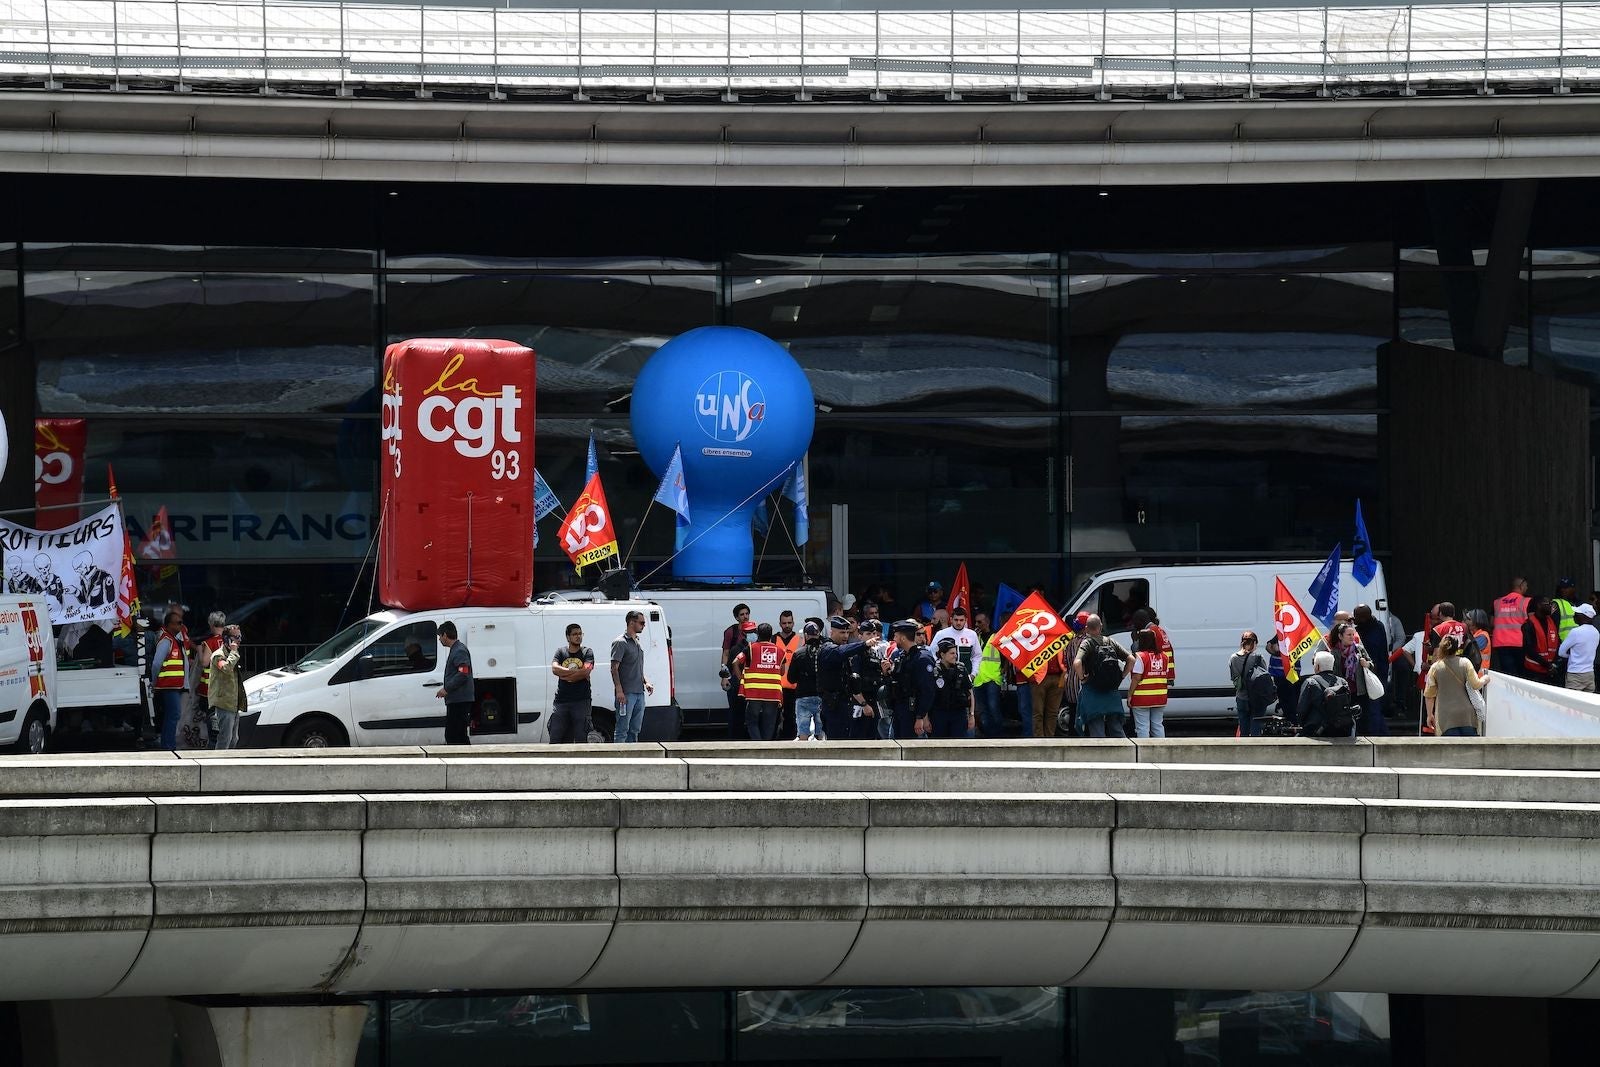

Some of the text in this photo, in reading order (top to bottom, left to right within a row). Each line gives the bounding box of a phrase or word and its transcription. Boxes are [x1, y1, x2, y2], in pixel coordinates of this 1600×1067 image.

[423, 353, 522, 396] la
[417, 384, 522, 458] cgt
[491, 450, 520, 481] 93
[722, 449, 751, 457] ensemble
[127, 513, 376, 542] ARFRANC
[761, 653, 776, 663] cgt
